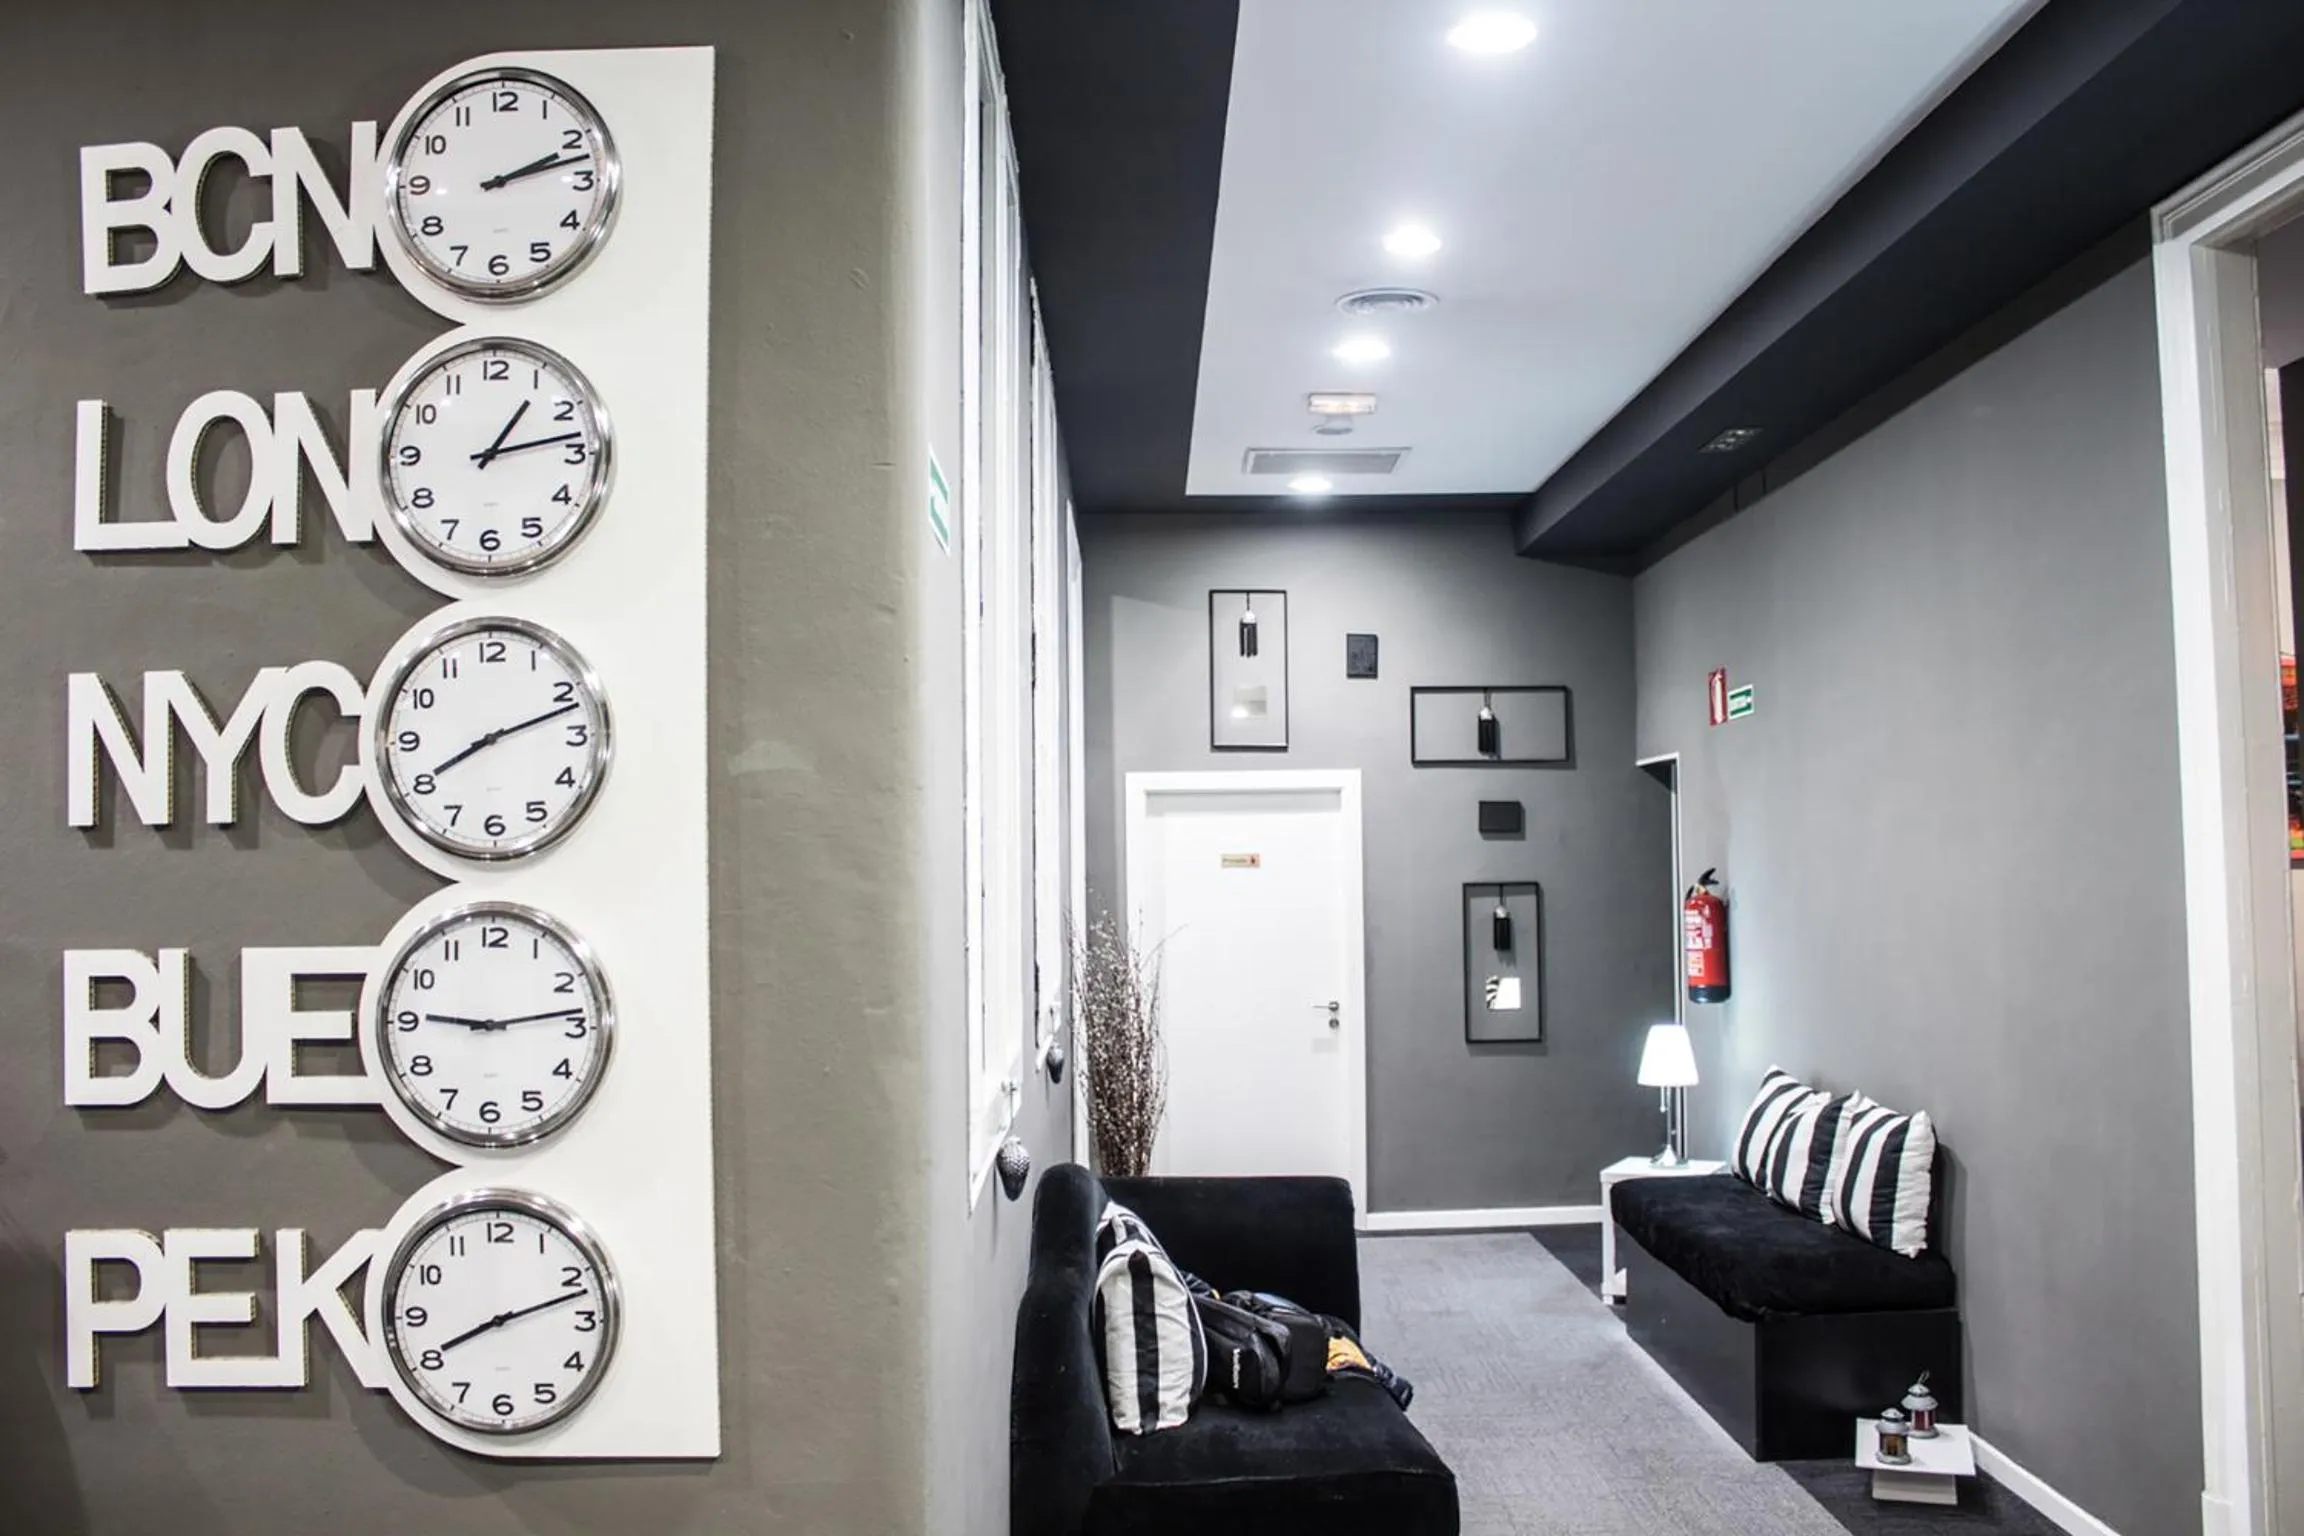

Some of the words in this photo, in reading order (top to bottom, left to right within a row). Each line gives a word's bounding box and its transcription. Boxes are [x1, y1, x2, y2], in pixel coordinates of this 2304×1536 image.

[492, 90, 519, 113] 12
[455, 106, 471, 127] 11
[425, 134, 447, 156] 10
[561, 129, 583, 150] 2
[408, 175, 431, 196] 9
[572, 169, 595, 192] 3
[80, 120, 377, 294] BCN
[420, 215, 445, 237] 8
[559, 209, 581, 231] 4
[449, 244, 469, 267] 7
[529, 241, 552, 264] 5
[487, 254, 510, 277] 6
[483, 359, 510, 381] 12
[446, 374, 461, 395] 11
[415, 403, 437, 425] 10
[553, 400, 575, 422] 2
[399, 445, 422, 467] 9
[563, 442, 587, 465] 3
[74, 388, 376, 551] LON
[411, 487, 435, 509] 8
[551, 484, 573, 506] 4
[440, 518, 460, 541] 7
[521, 516, 544, 539] 5
[479, 529, 501, 552] 6
[479, 641, 506, 663] 12
[442, 658, 458, 679] 11
[412, 687, 435, 710] 10
[552, 681, 574, 703] 2
[68, 660, 366, 827] NYC
[398, 730, 421, 753] 9
[565, 724, 588, 747] 3
[412, 773, 437, 796] 8
[554, 766, 576, 788] 4
[443, 804, 463, 827] 7
[525, 800, 548, 823] 5
[483, 814, 507, 837] 6
[481, 926, 509, 949] 12
[444, 939, 459, 961] 11
[413, 968, 435, 991] 10
[553, 972, 575, 994] 2
[64, 946, 382, 1109] BUE
[397, 1010, 420, 1033] 9
[564, 1016, 587, 1040] 3
[409, 1054, 434, 1077] 8
[552, 1057, 573, 1080] 4
[439, 1088, 459, 1111] 7
[521, 1090, 544, 1113] 5
[478, 1100, 501, 1124] 6
[486, 1221, 515, 1244] 12
[449, 1235, 465, 1257] 11
[419, 1264, 442, 1286] 10
[561, 1266, 583, 1288] 2
[65, 1228, 390, 1388] PEK
[404, 1306, 429, 1328] 9
[573, 1310, 597, 1333] 3
[419, 1349, 445, 1371] 8
[563, 1350, 585, 1373] 4
[451, 1381, 471, 1404] 7
[534, 1383, 557, 1405] 5
[491, 1393, 515, 1417] 6
